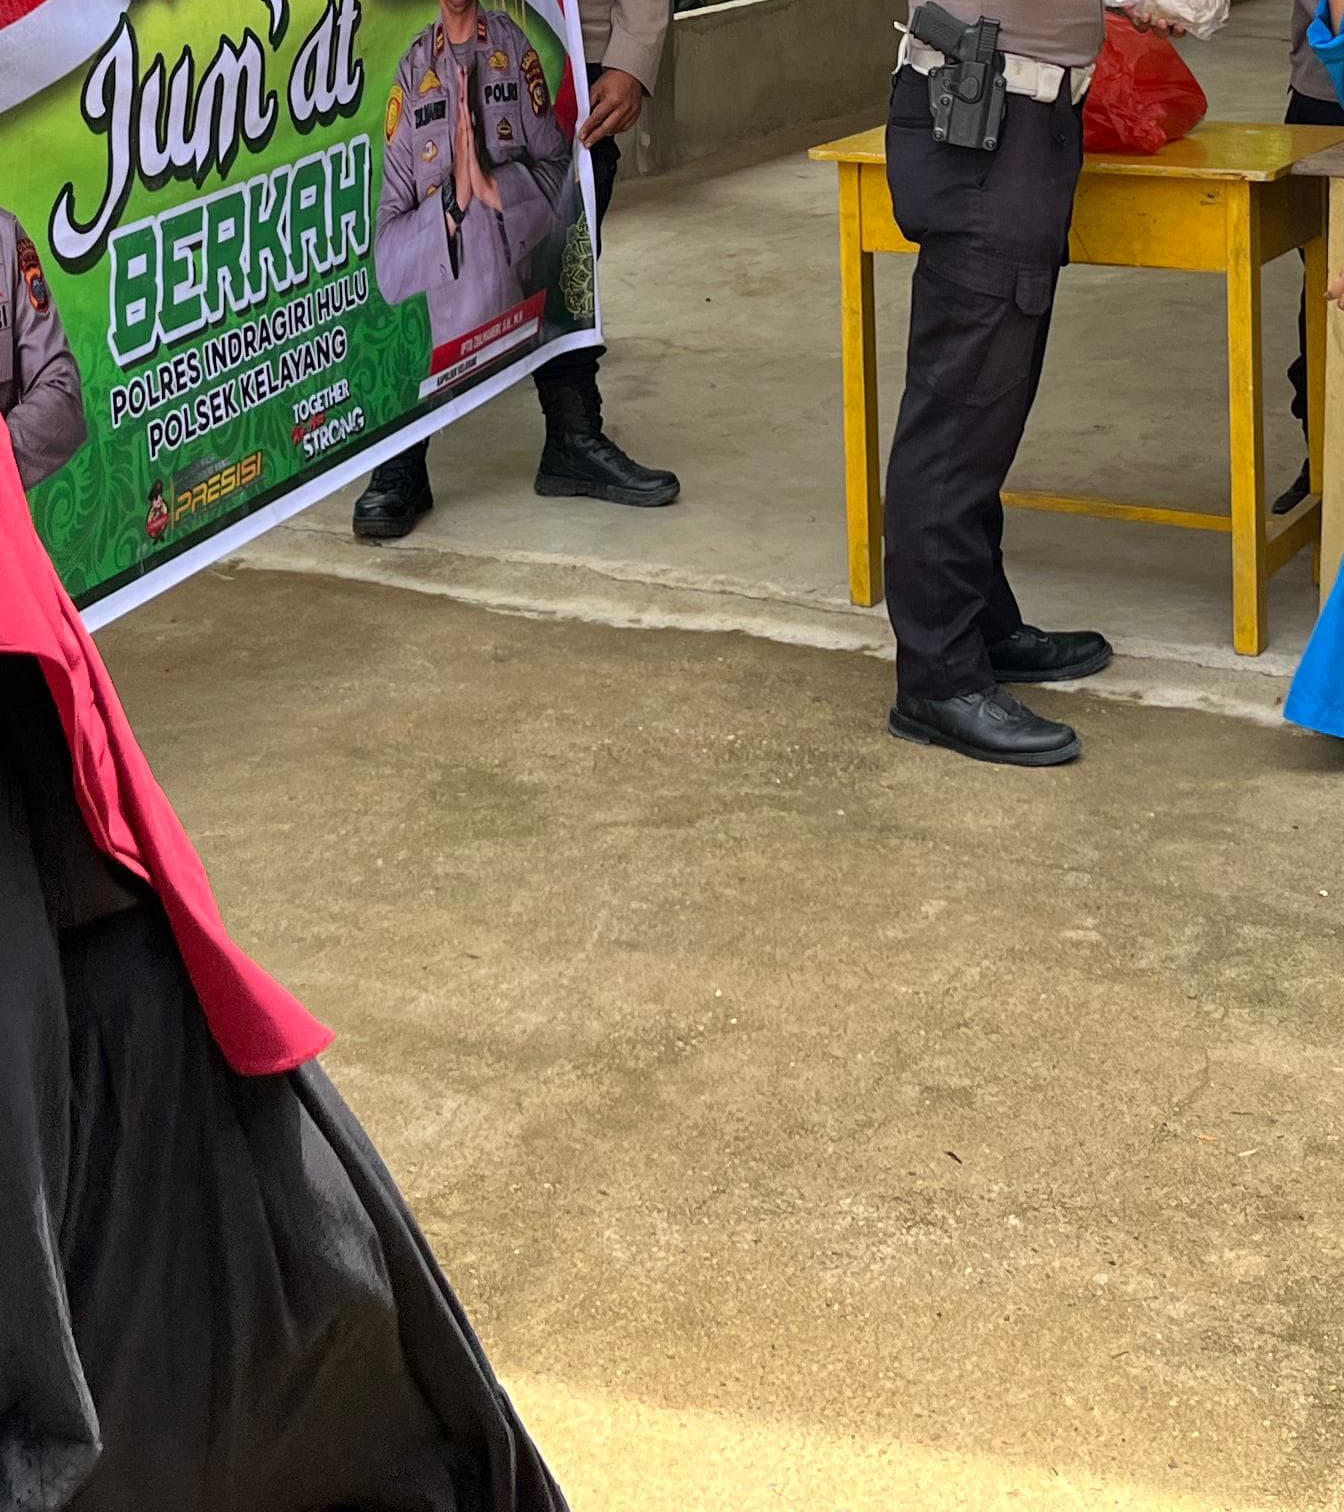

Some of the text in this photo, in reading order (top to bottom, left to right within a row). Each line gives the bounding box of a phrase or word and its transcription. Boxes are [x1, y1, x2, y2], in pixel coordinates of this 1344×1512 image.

[108, 134, 371, 367] BERKAH
[112, 269, 368, 426] POLRES INDRAGIRI HULU
[148, 327, 346, 460] POLSEK KELAYANG
[293, 379, 350, 424] TOGETHER
[303, 407, 365, 458] STRONG
[175, 451, 262, 521] PRESISI
